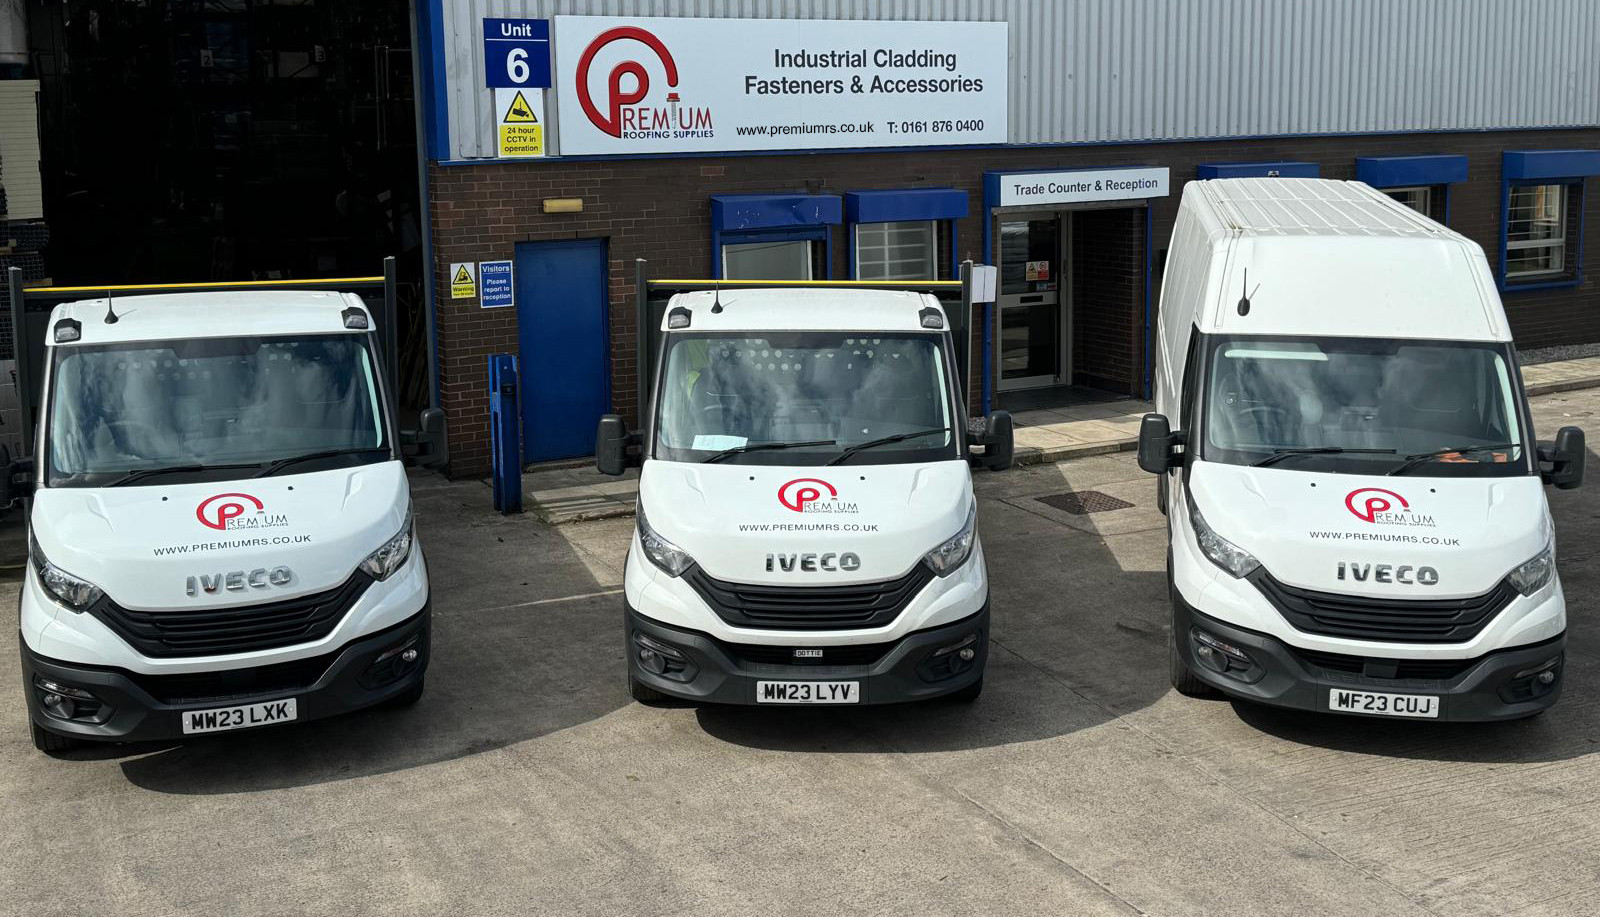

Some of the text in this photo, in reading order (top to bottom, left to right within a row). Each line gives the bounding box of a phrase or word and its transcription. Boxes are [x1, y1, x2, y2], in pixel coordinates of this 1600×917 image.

[501, 23, 532, 37] Unit
[506, 47, 530, 84] 6
[775, 49, 957, 72] Industrial Cladding
[744, 75, 984, 94] Fasteners & Accessories
[623, 130, 714, 139] ROOFING SUPPLIES
[736, 120, 984, 137] www.premiumrs.co.uk T: 0161 876 0400
[504, 145, 539, 153] operation
[1014, 178, 1158, 196] Trade Counter & Reception
[483, 293, 511, 301] reception
[739, 524, 879, 532] WWW.PREMIUMRS.CO.UK
[153, 534, 311, 556] WWW.PREMIUMRS.CO.UK
[1309, 531, 1460, 546] WWW.PREMIUMRS.CO.UK
[765, 552, 861, 572] IVECO
[186, 565, 292, 596] IVECO
[1337, 561, 1439, 586] IVECO
[764, 684, 850, 700] MW23 LYV
[1338, 692, 1430, 713] MF23 CUJ
[191, 702, 288, 730] MW23 LXK
